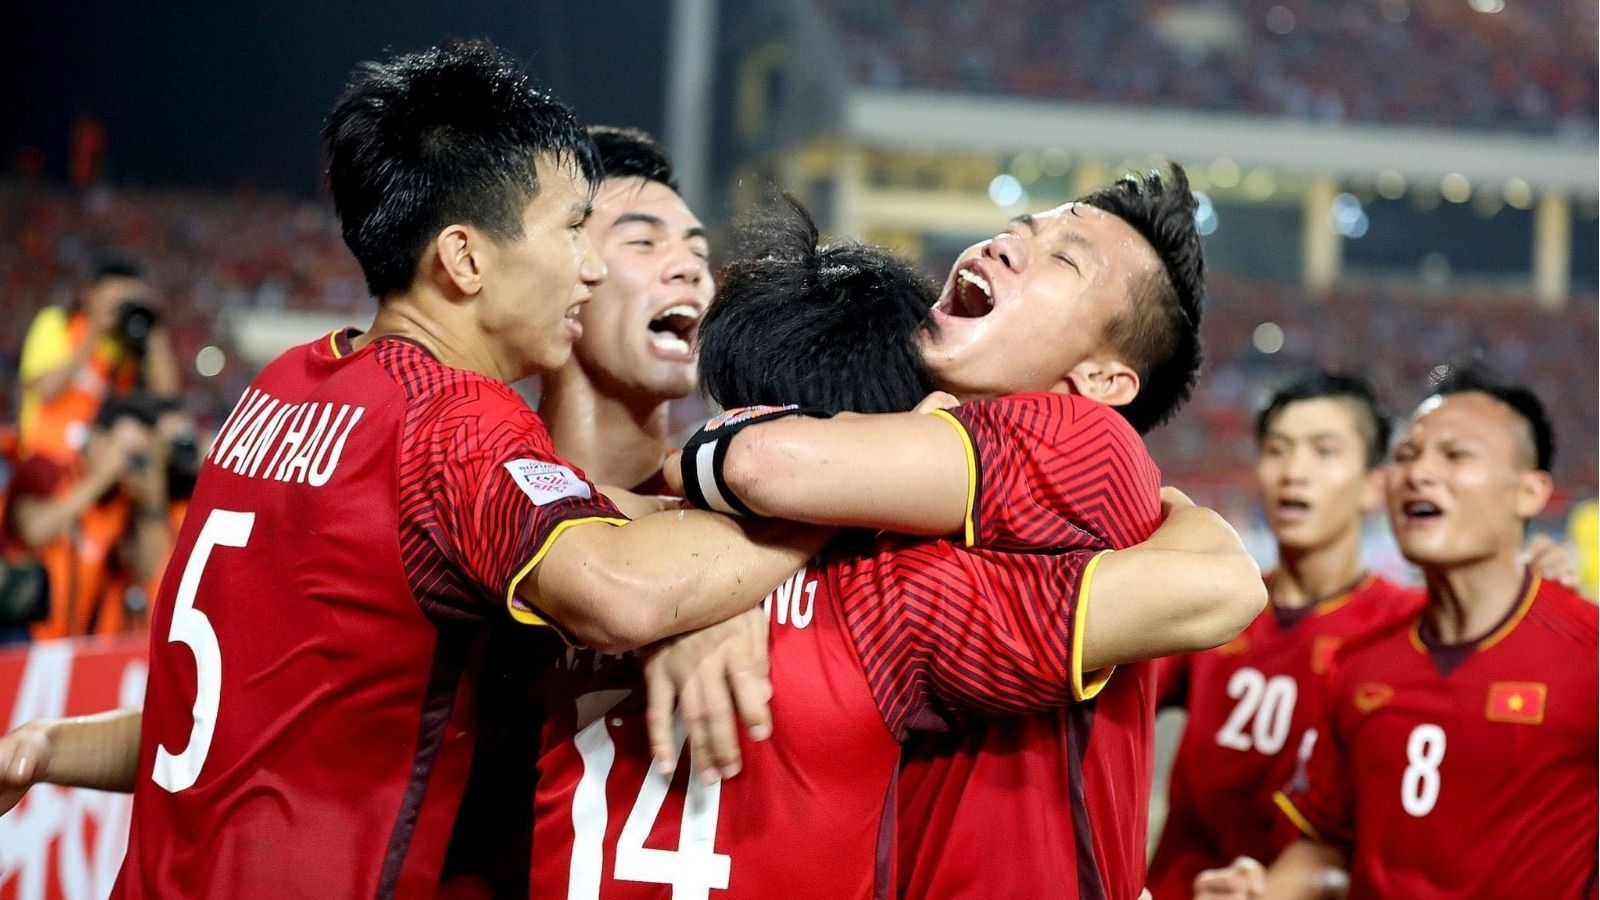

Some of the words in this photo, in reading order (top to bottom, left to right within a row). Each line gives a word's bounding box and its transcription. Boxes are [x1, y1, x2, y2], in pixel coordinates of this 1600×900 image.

[262, 402, 366, 487] HAU
[151, 508, 256, 793] 5
[1215, 667, 1298, 755] 20
[566, 688, 732, 900] 14
[1401, 723, 1447, 818] 8
